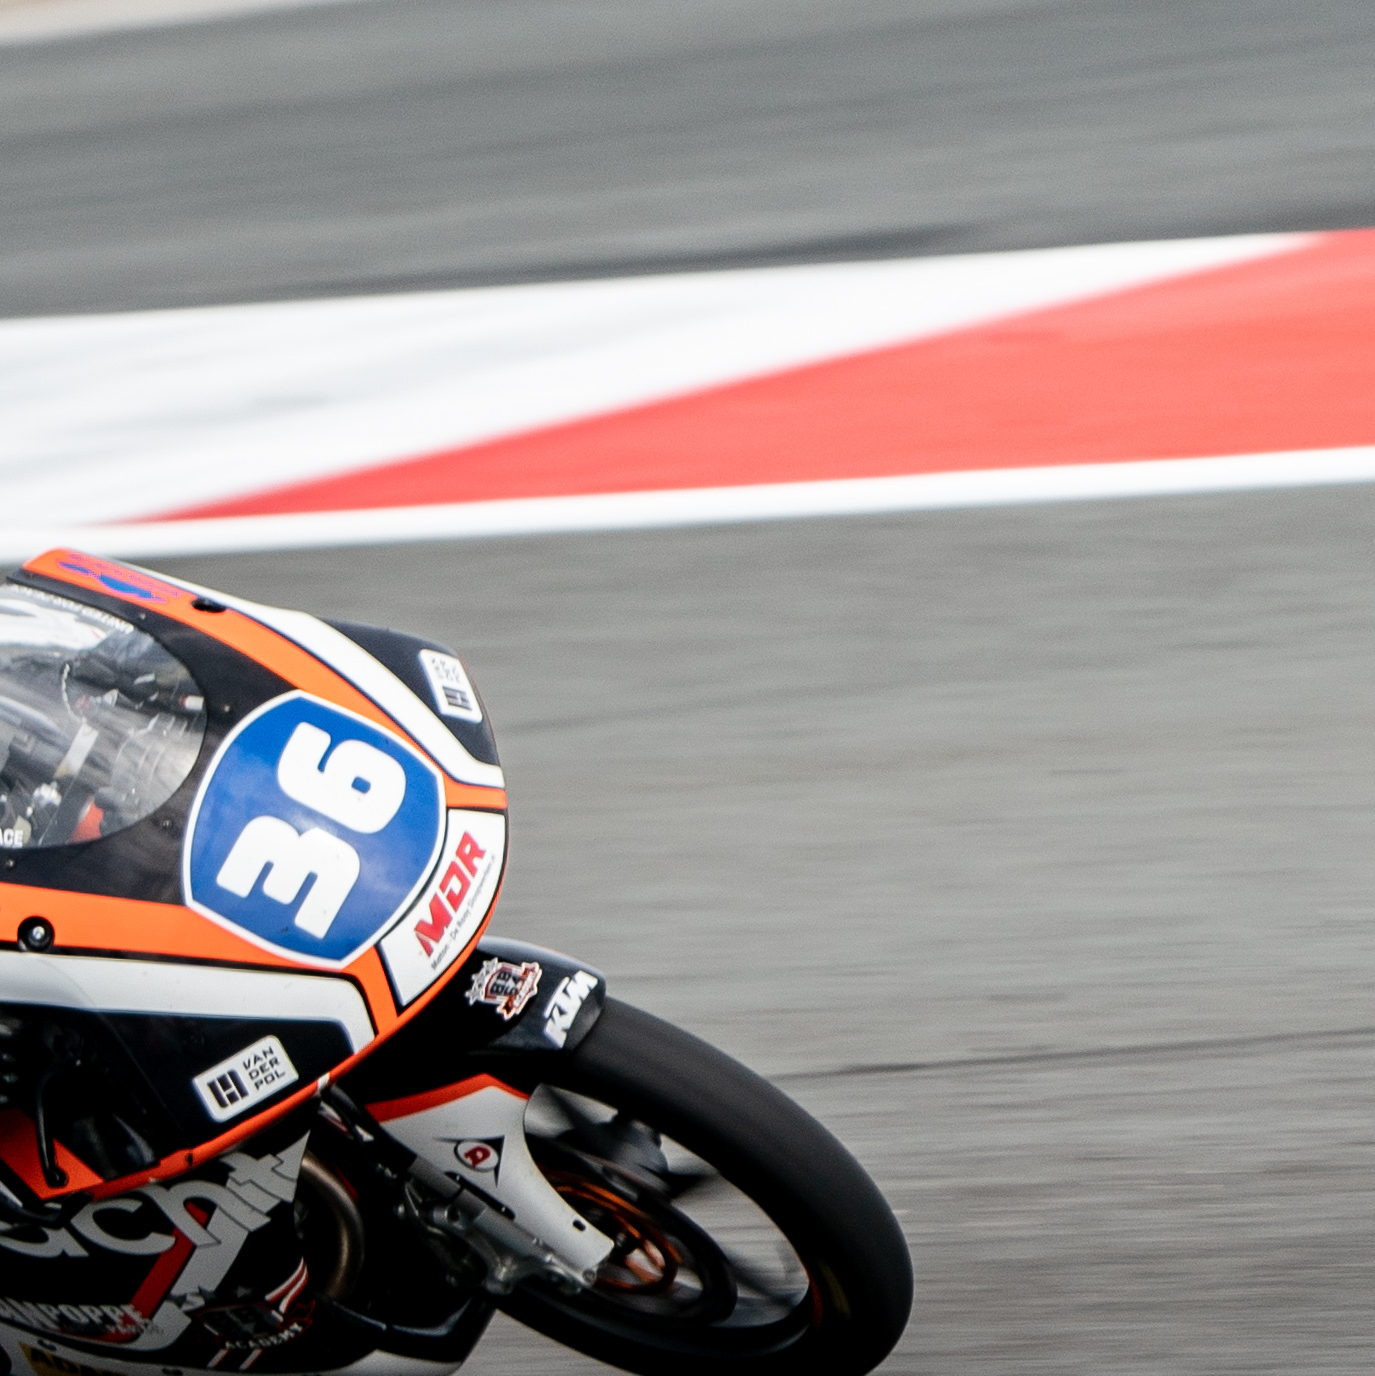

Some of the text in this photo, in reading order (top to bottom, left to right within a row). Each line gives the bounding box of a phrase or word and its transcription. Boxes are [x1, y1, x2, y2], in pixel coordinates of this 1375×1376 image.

[216, 722, 406, 939] 36
[414, 831, 486, 957] MDR
[543, 970, 598, 1048] KTM
[242, 1045, 274, 1070] VAN
[249, 1056, 280, 1081] DER
[254, 1070, 286, 1092] POL
[224, 1322, 304, 1350] ACADEMY
